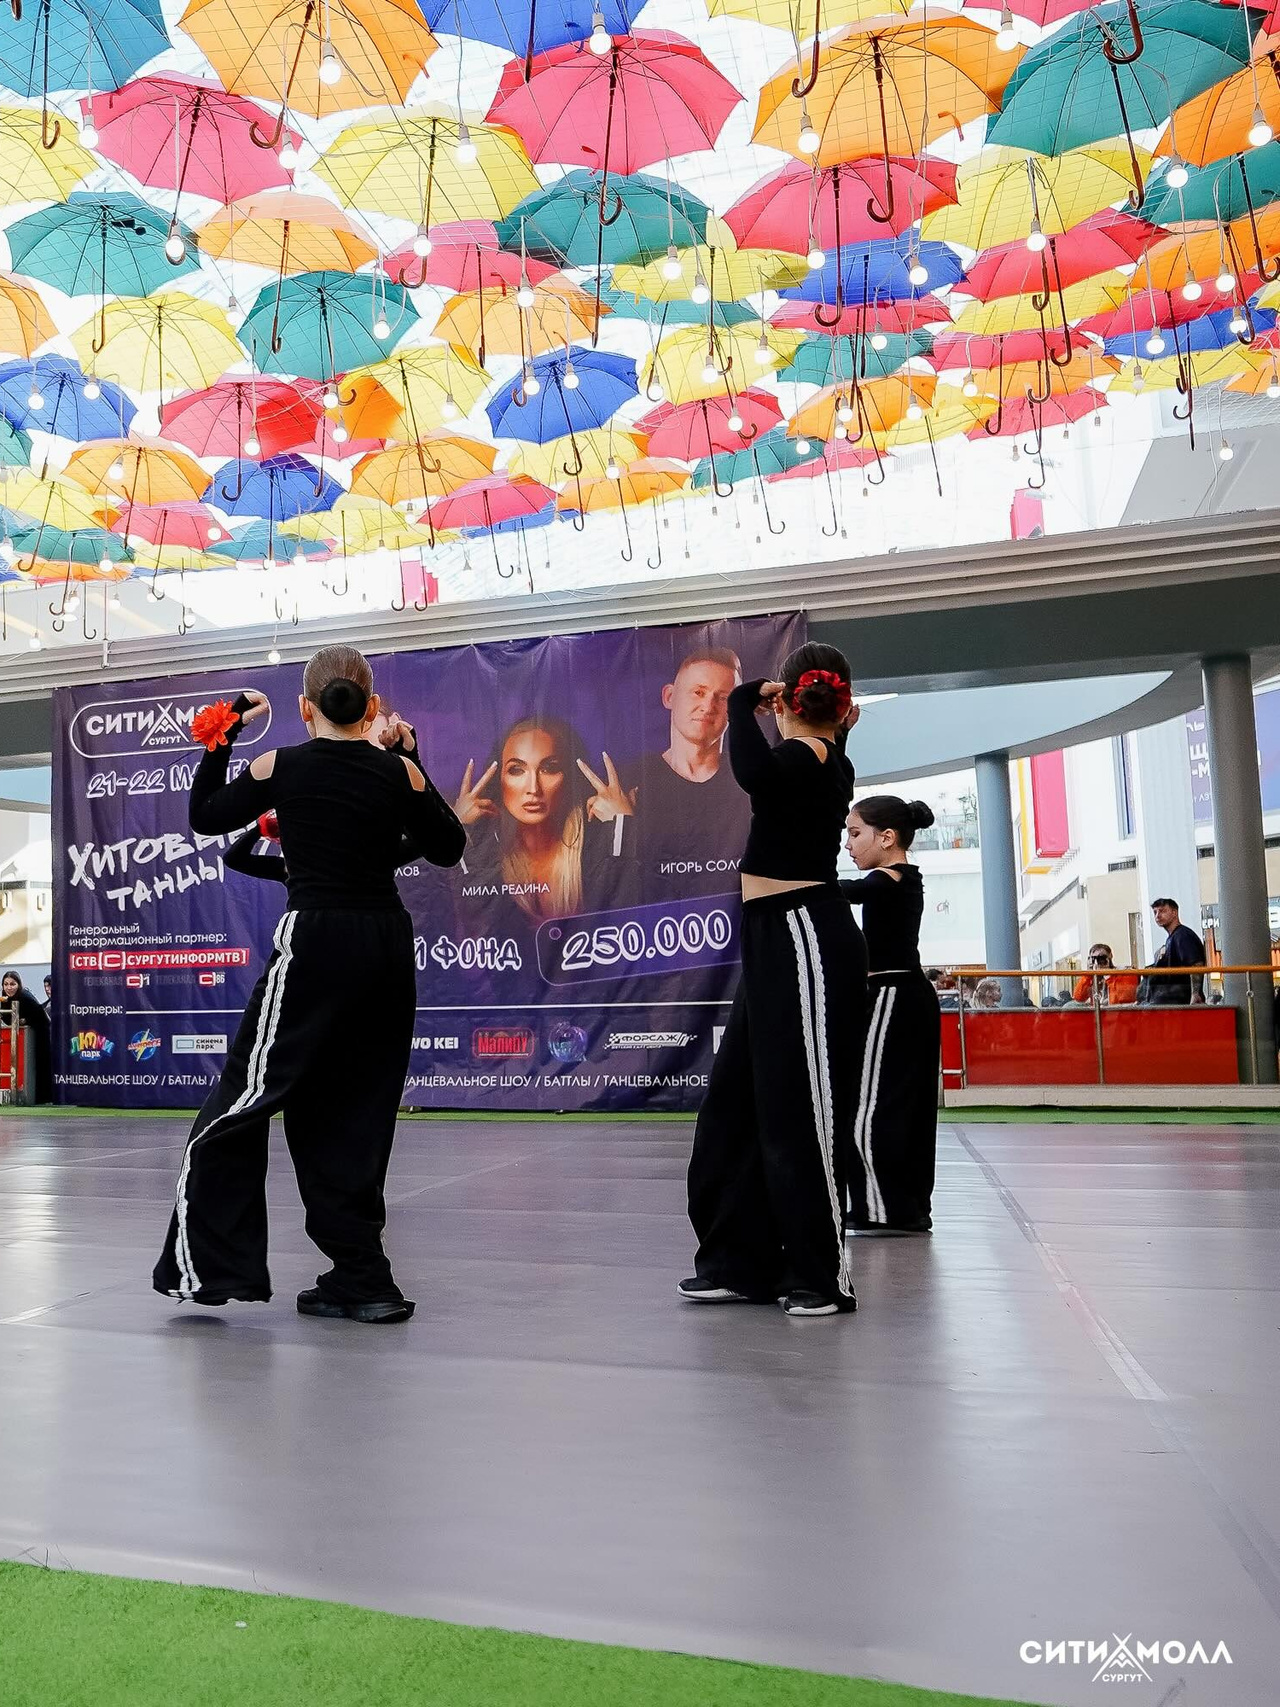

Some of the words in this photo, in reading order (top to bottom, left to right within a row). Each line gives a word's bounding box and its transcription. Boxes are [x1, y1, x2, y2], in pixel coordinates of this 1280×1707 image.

[86, 710, 154, 736] СИТИ
[148, 735, 182, 746] СУРГУТ
[86, 769, 166, 799] 21-22
[660, 861, 703, 874] ИГОРЬ
[106, 855, 224, 912] ТАНЦЫ
[462, 885, 499, 897] МИЛА
[501, 882, 551, 896] РЕДИНА
[70, 922, 140, 936] Генеральный
[70, 932, 172, 948] информационный
[175, 933, 228, 945] партнер:
[561, 909, 732, 972] 250.000
[431, 935, 522, 971] ФОНД
[70, 1004, 123, 1016] Партнеры:
[434, 1037, 459, 1049] KEI
[621, 1034, 678, 1042] ФОРСАЖ
[81, 1050, 101, 1059] парк
[54, 1074, 131, 1086] ТАНЦЕВАЛЬНОЕ
[132, 1074, 159, 1086] ШОУ
[168, 1074, 207, 1086] БАТТЛЫ
[500, 1075, 532, 1087] ШОУ
[544, 1075, 591, 1087] БАТТЛЫ
[603, 1075, 708, 1087] ТАНЦЕВАЛЬНОЕ
